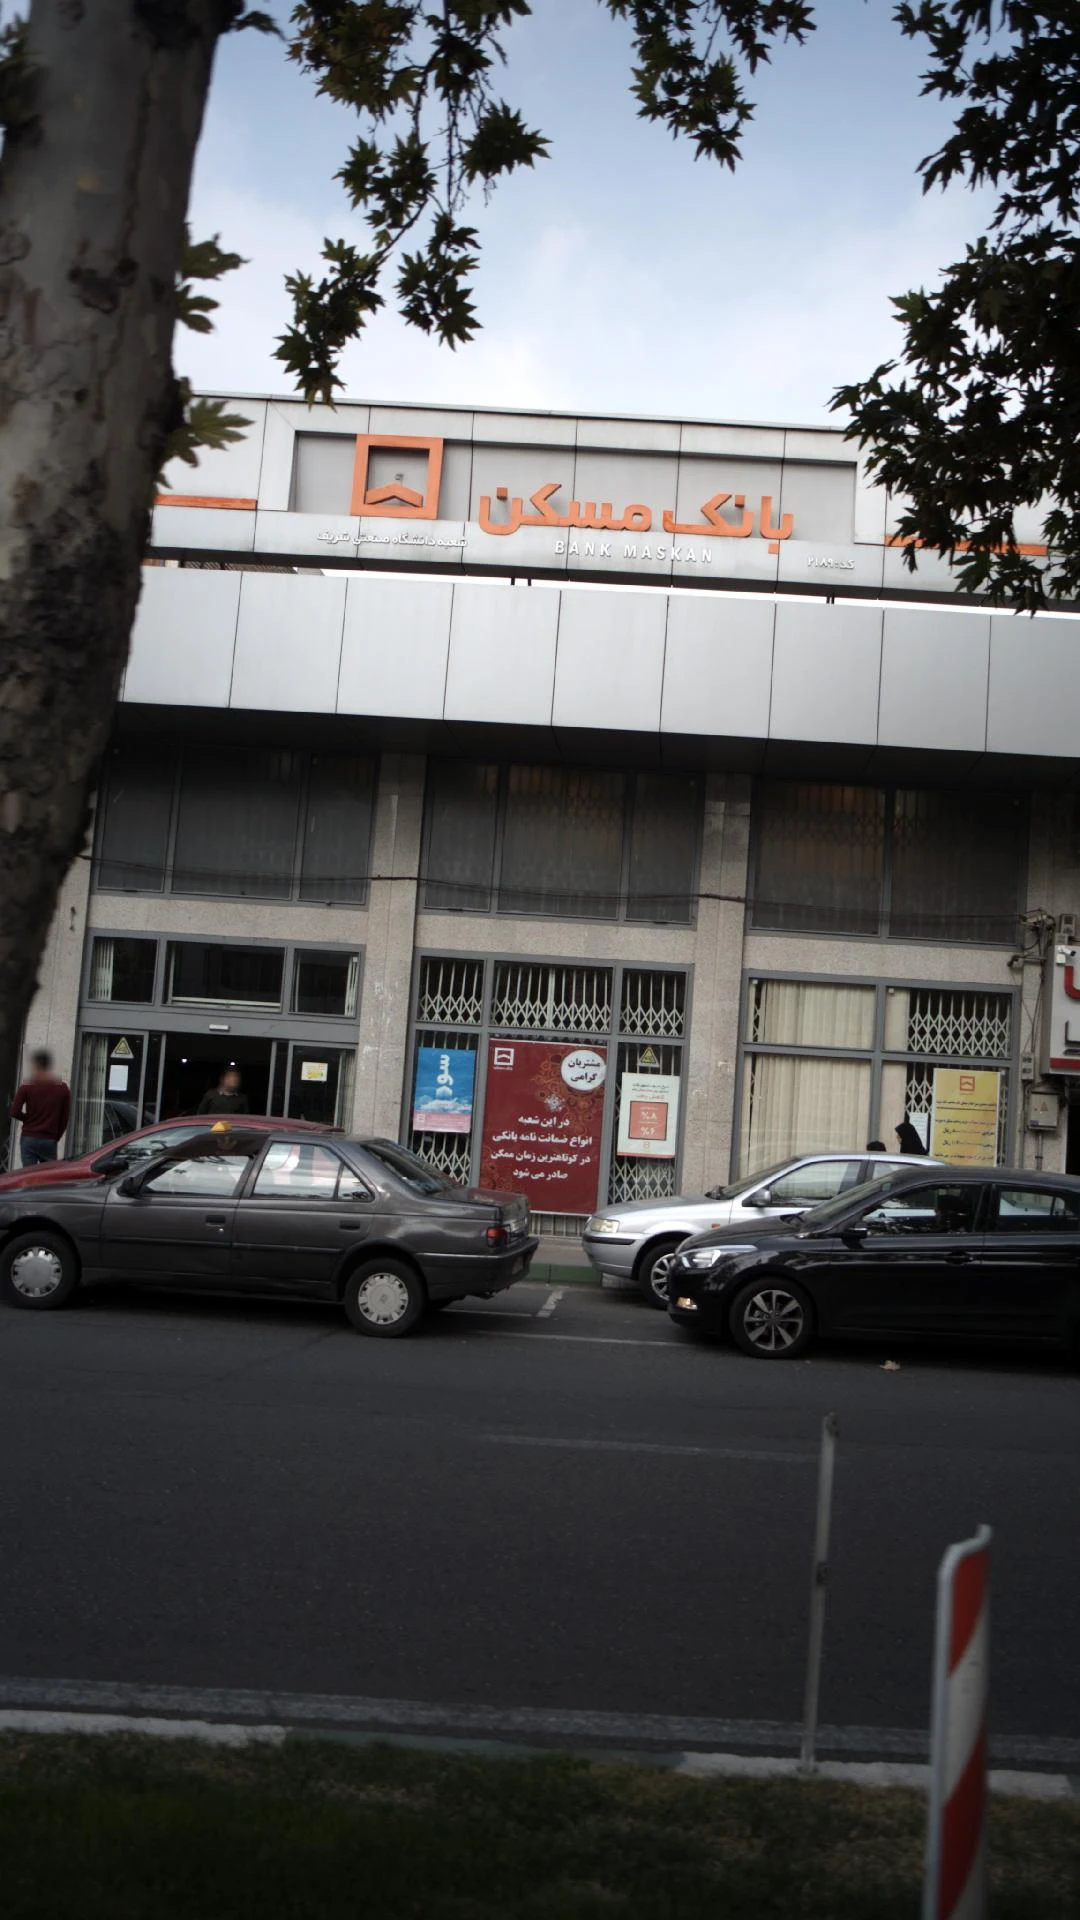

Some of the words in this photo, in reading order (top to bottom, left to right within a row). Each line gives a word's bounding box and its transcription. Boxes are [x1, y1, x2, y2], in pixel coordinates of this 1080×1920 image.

[479, 483, 651, 536] مسکن
[662, 493, 794, 554] بانک
[317, 529, 350, 544] شریف
[352, 533, 390, 546] صنعتی
[392, 530, 436, 546] دانشگاه
[437, 536, 468, 550] شعبه
[554, 540, 611, 558] BANK
[623, 544, 713, 563] MASKAN
[568, 1058, 601, 1069] مشتریان
[570, 1072, 598, 1083] گرامی
[518, 1115, 540, 1126] شعبه
[540, 1116, 557, 1128] این
[558, 1118, 570, 1128] در
[492, 1130, 518, 1142] بانکی
[519, 1131, 537, 1142] نامه
[538, 1132, 568, 1144] ضمانت
[569, 1135, 593, 1147] انواع
[490, 1148, 514, 1159] ممکن
[515, 1150, 536, 1162] زمان
[579, 1155, 592, 1165] در
[512, 1167, 530, 1179] شود
[531, 1172, 545, 1180] می
[546, 1169, 569, 1180] صادر
